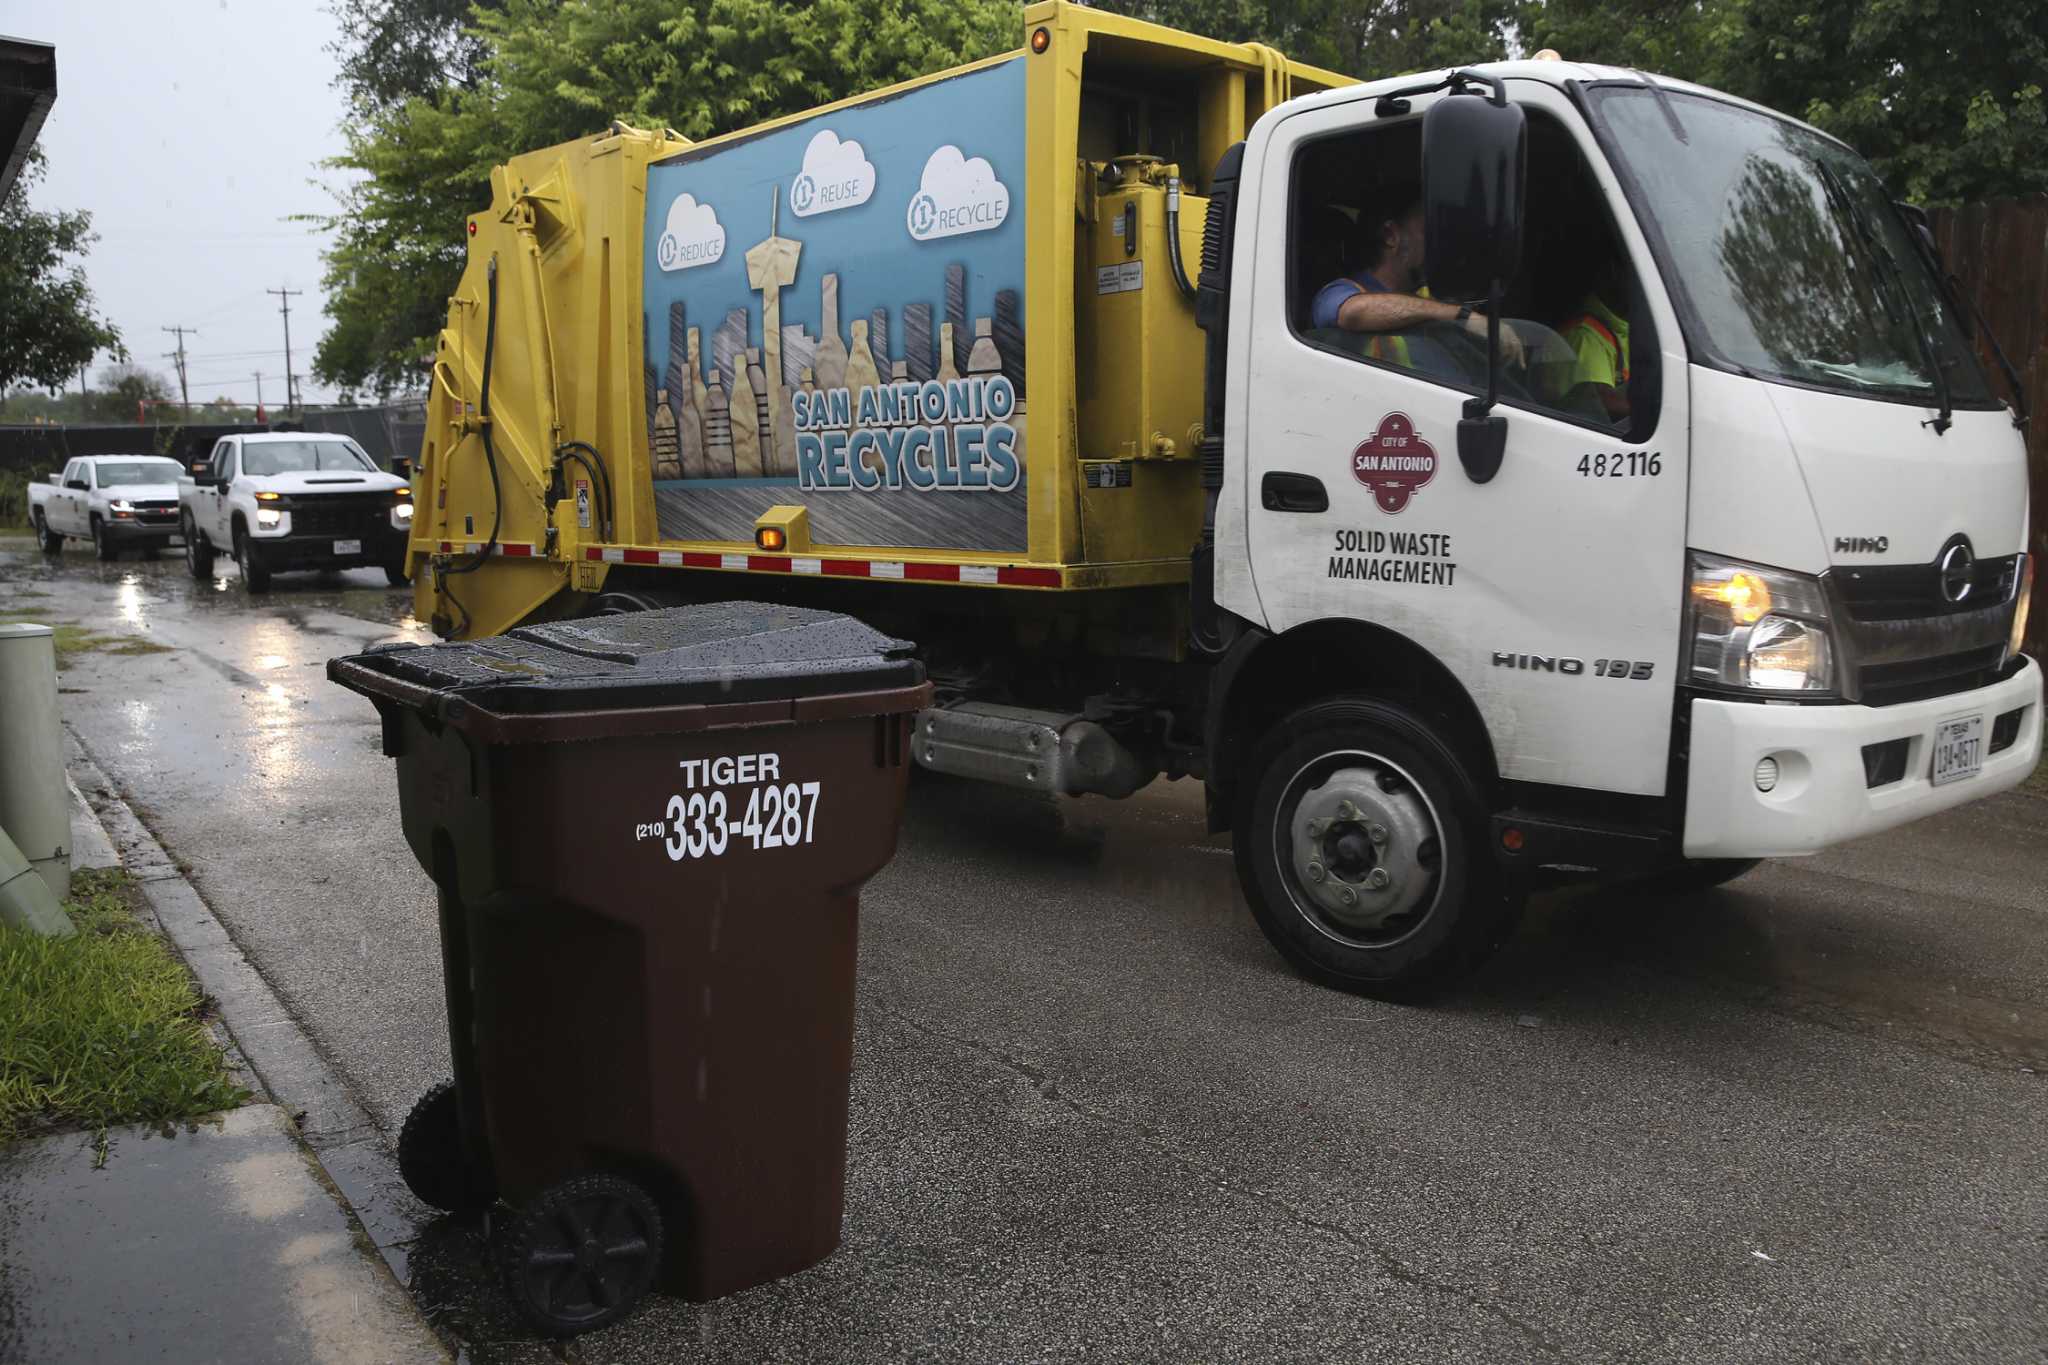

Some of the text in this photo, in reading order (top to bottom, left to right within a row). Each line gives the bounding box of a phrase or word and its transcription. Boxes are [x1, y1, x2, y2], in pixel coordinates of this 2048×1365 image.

[820, 179, 859, 205] REUSE
[938, 200, 1003, 229] RECYCLE
[680, 239, 720, 262] REDUCE
[792, 376, 1015, 431] SAN ANTONIO
[796, 422, 1020, 493] RECYCLES
[1355, 456, 1433, 471] SAN ANTONIO
[1576, 452, 1661, 478] 482116
[1335, 530, 1450, 557] SOLID WASTE
[1834, 536, 1888, 553] HINO
[1328, 557, 1457, 586] MANAGEMENT
[1491, 651, 1655, 681] HINO 195
[679, 753, 780, 789] TIGER
[636, 782, 821, 861] (210) 333-4287
